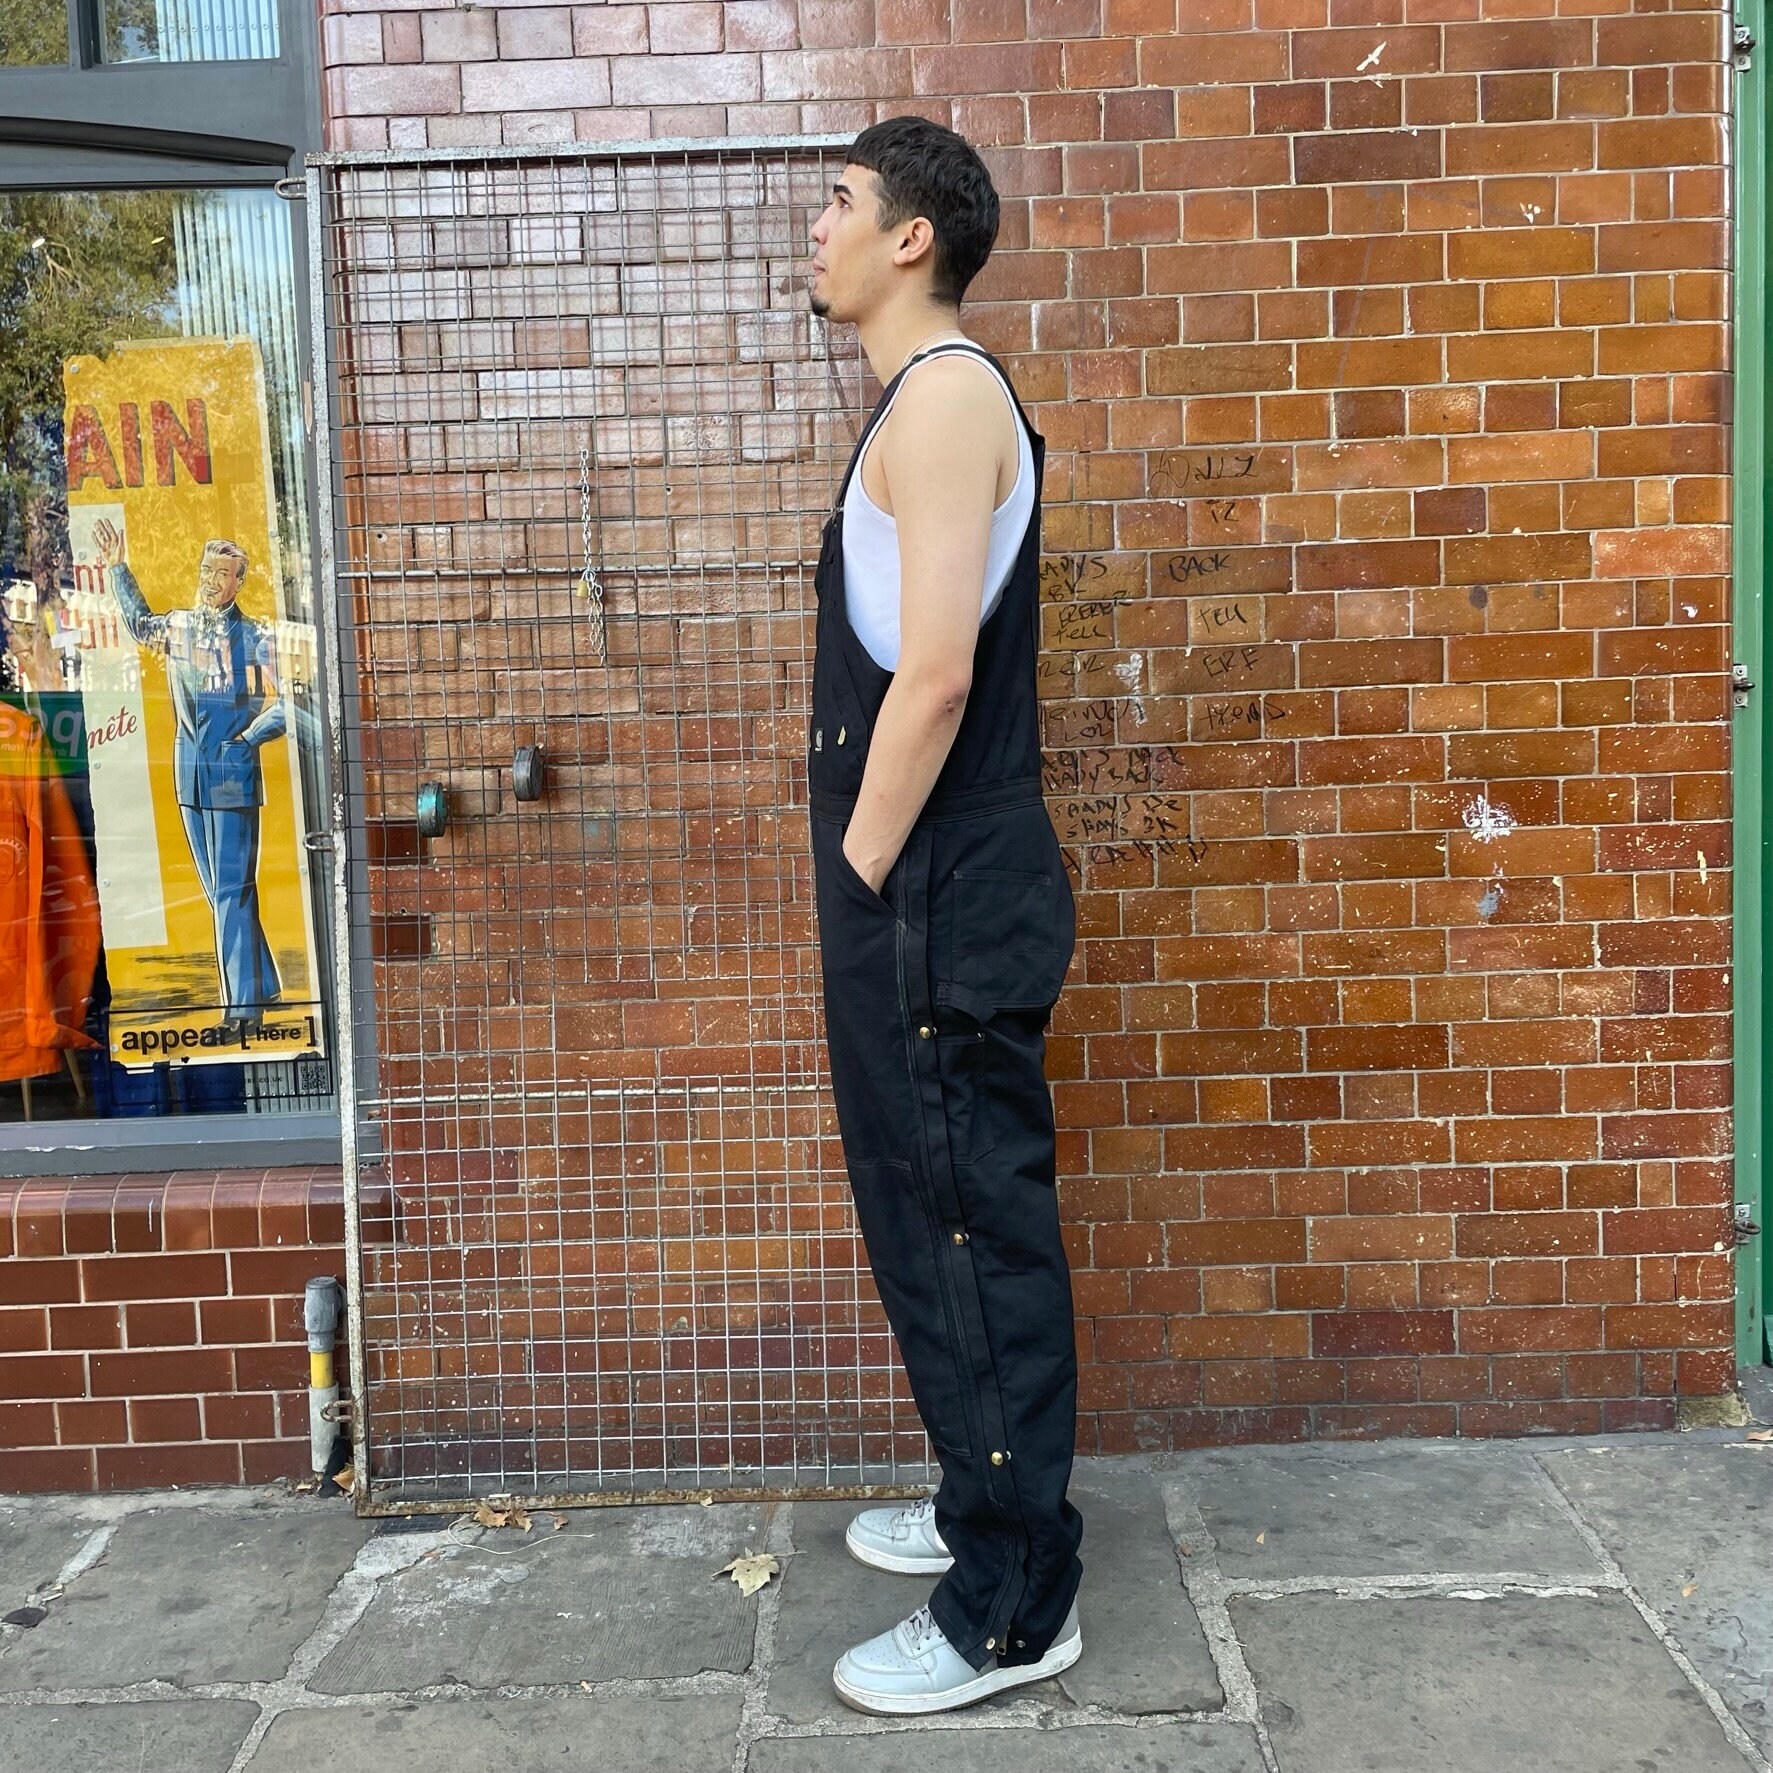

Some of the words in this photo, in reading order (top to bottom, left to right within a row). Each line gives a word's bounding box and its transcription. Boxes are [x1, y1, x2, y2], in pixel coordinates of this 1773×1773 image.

[66, 397, 213, 492] AIN
[1168, 553, 1230, 583] BACK
[121, 1025, 231, 1055] appear
